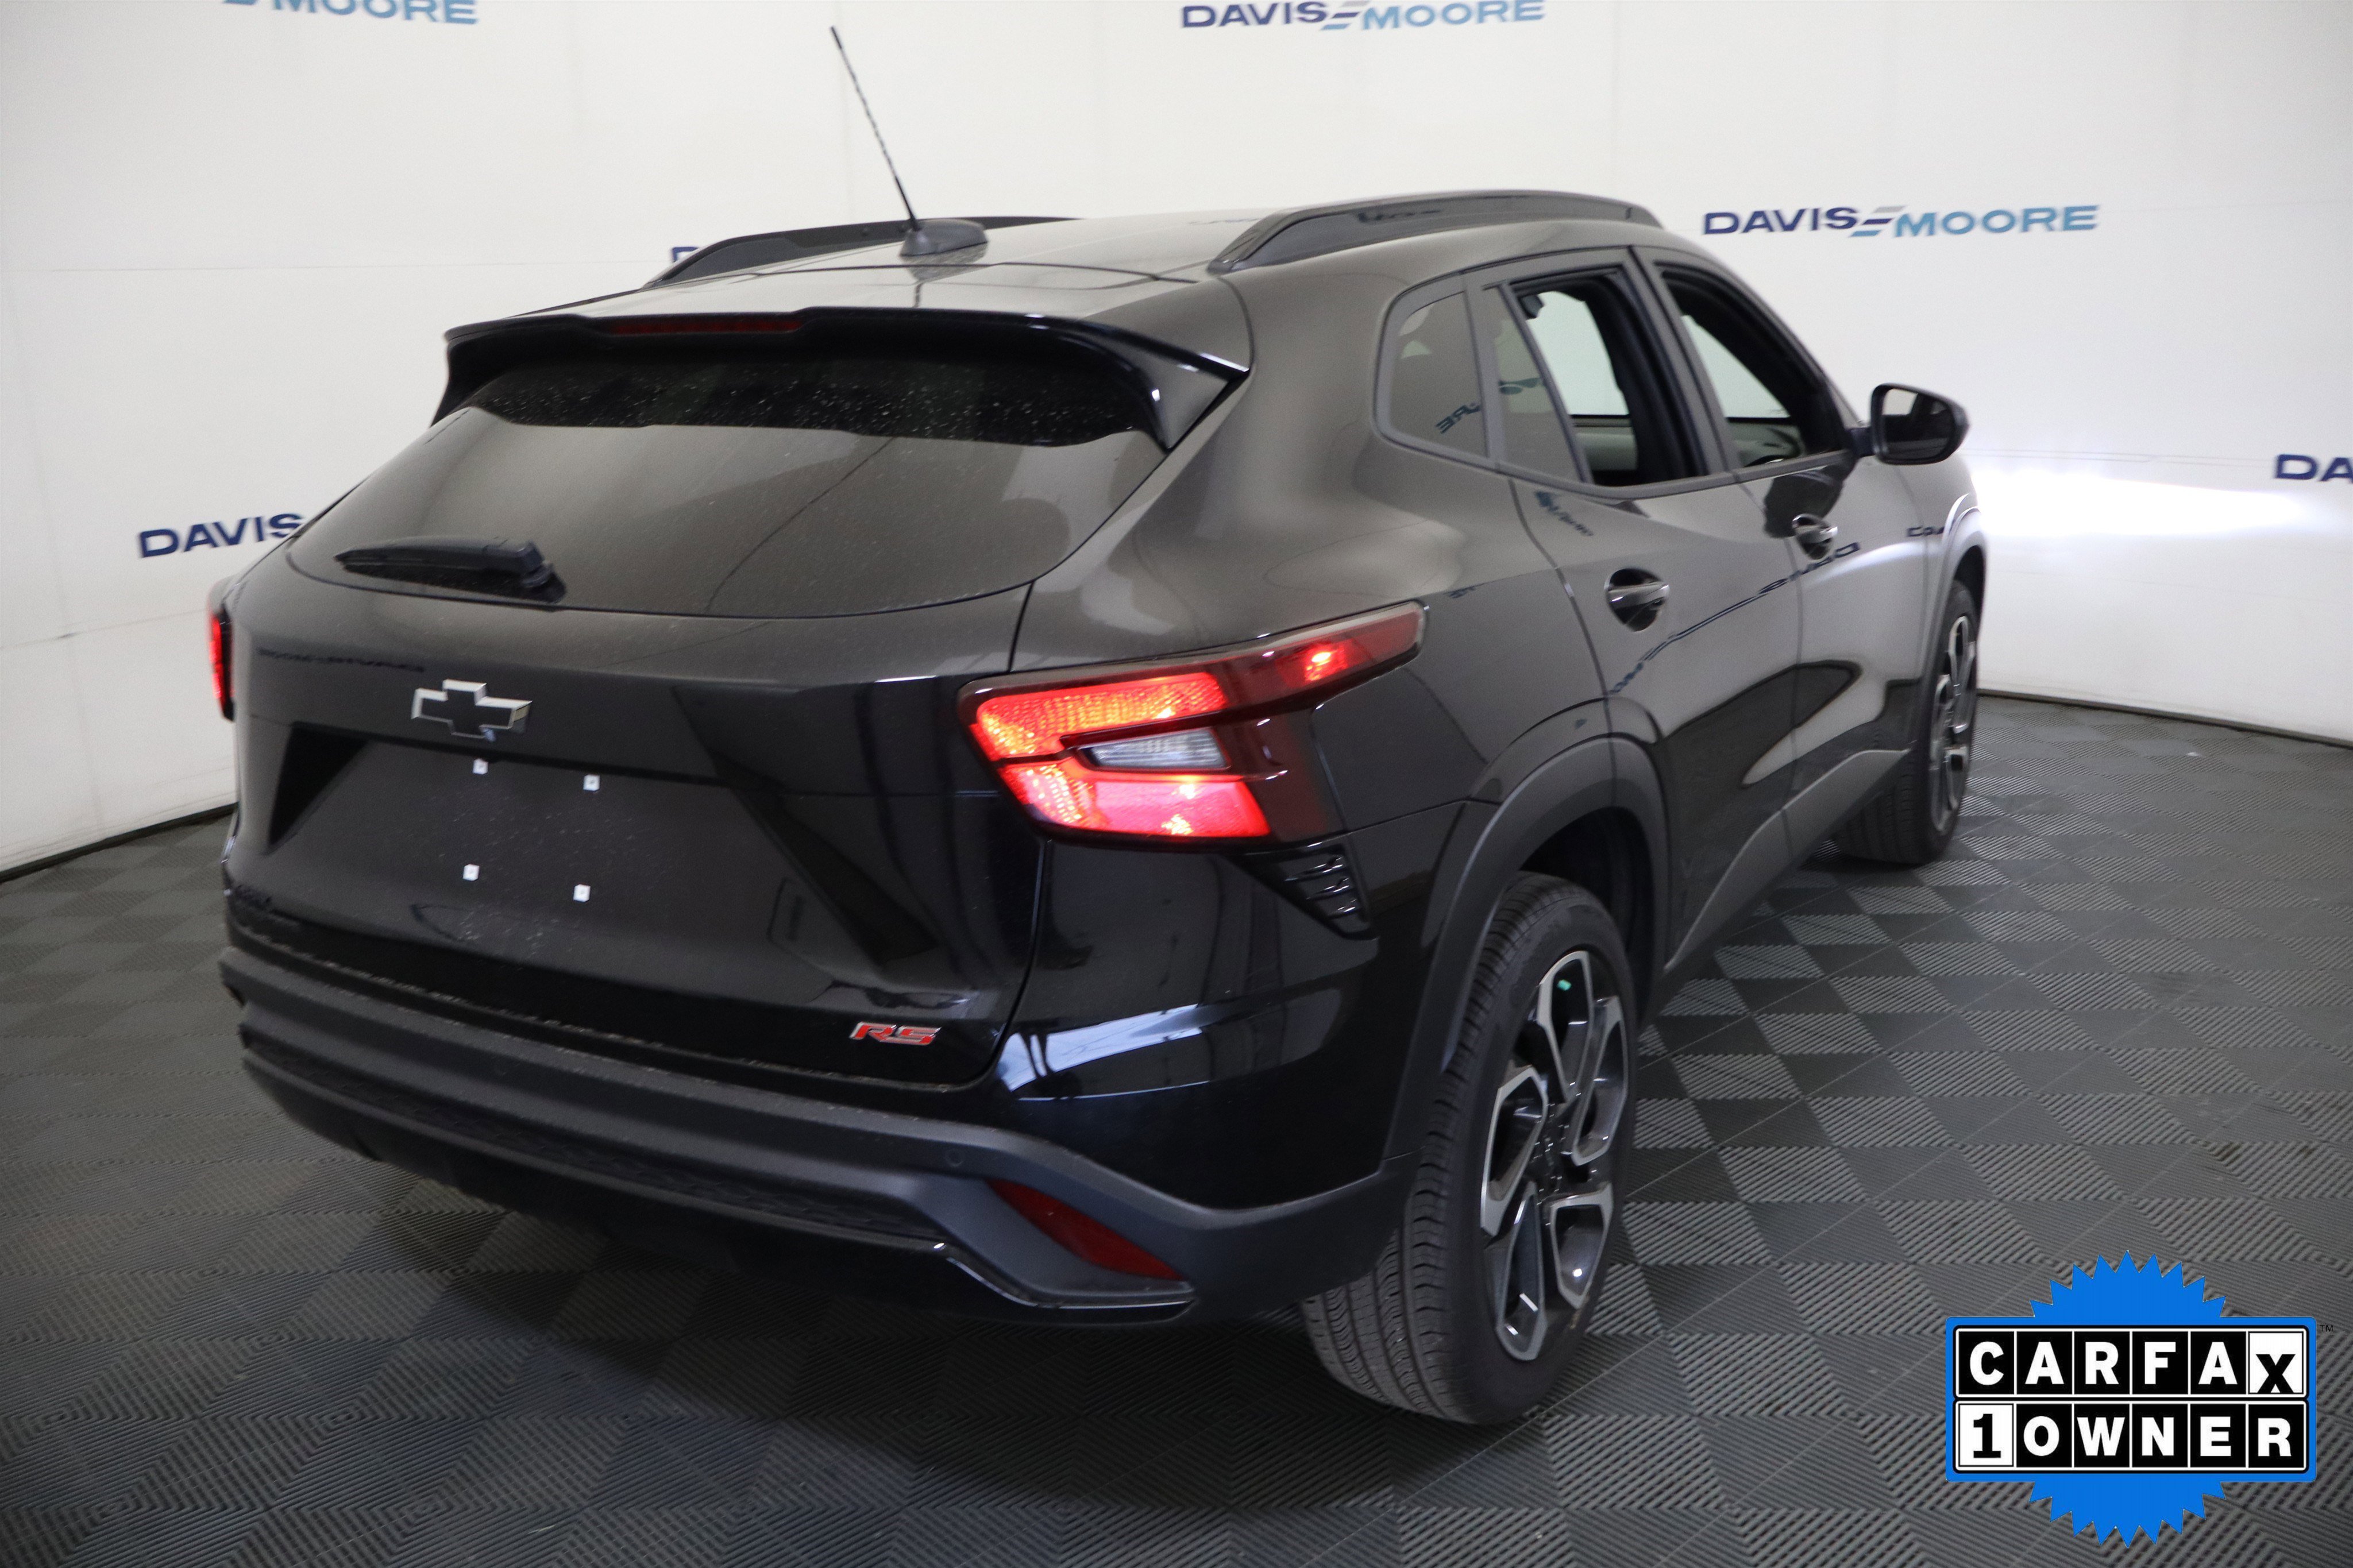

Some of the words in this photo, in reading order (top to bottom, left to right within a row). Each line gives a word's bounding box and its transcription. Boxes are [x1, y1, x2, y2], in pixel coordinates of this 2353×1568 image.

[1181, 1, 1329, 28] DAVIS
[1362, 0, 1545, 30] MOORE
[1702, 207, 1857, 235] DAVIS
[1893, 204, 2099, 237] MOORE
[137, 513, 303, 558] DAVIS
[848, 1021, 942, 1046] RS
